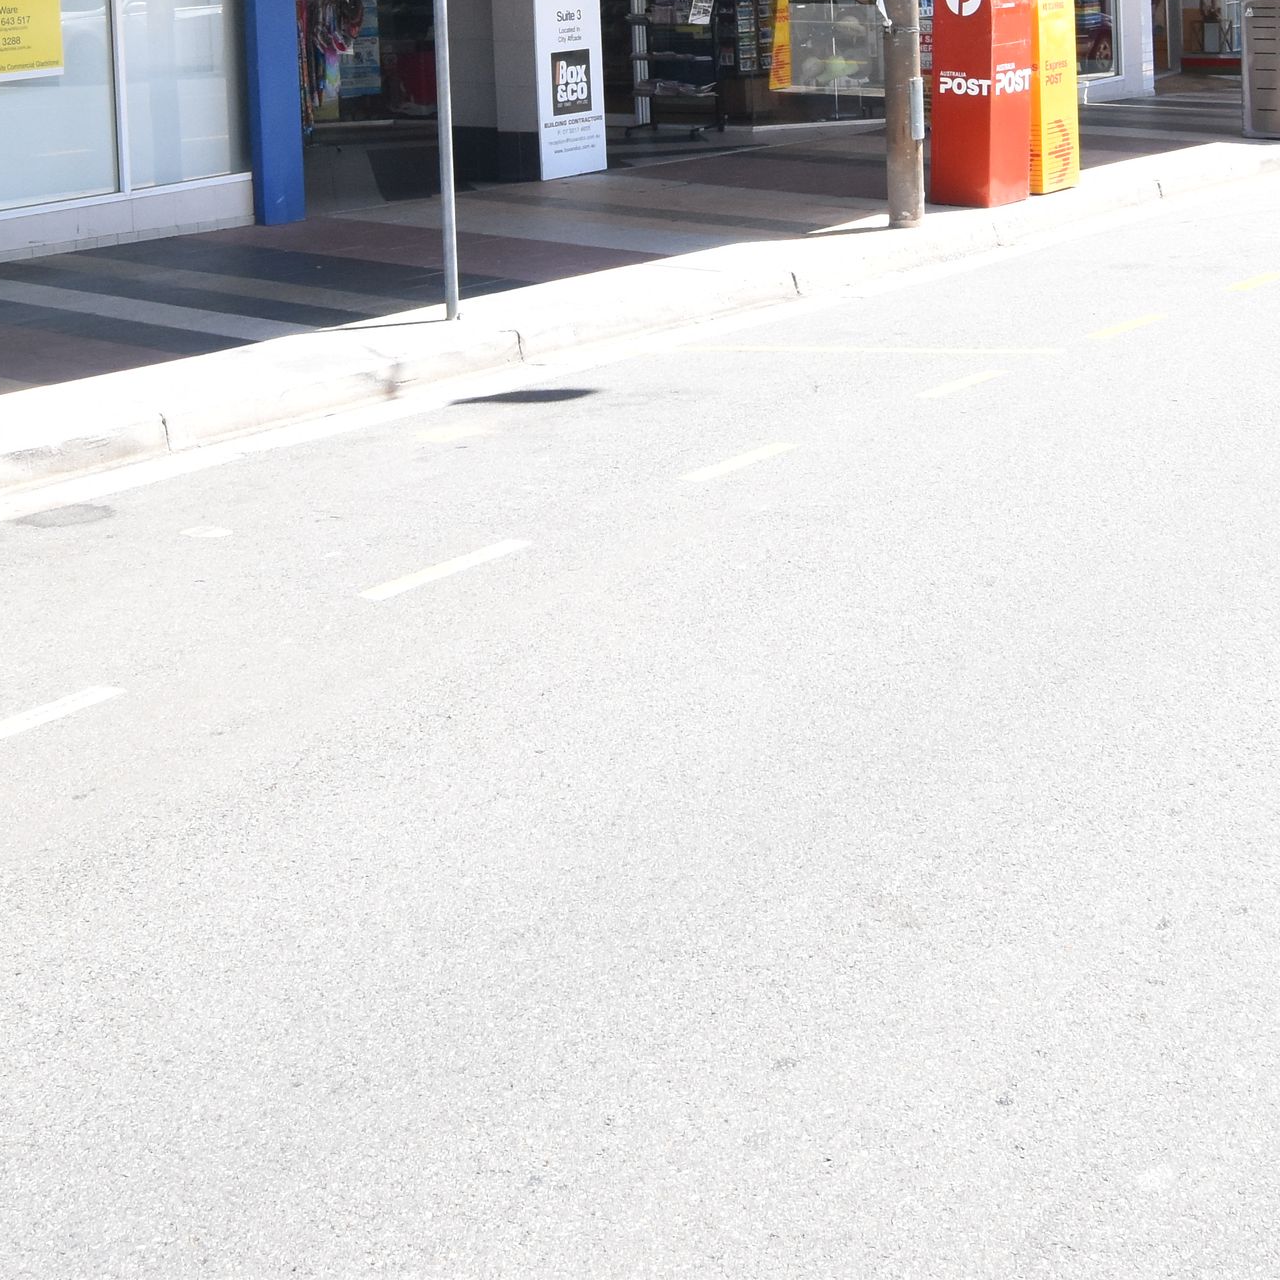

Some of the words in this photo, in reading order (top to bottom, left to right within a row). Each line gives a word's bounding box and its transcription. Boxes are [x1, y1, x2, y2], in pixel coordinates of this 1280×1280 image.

[1, 17, 15, 27] 643
[17, 16, 31, 25] 517
[557, 11, 575, 22] Suite
[576, 9, 582, 20] 3
[2, 36, 21, 46] 3288
[1045, 59, 1068, 72] Express
[995, 68, 1032, 96] POST
[1045, 74, 1062, 86] POST
[557, 82, 588, 103] &CO
[939, 78, 992, 96] POST
[544, 120, 567, 129] BUILDING
